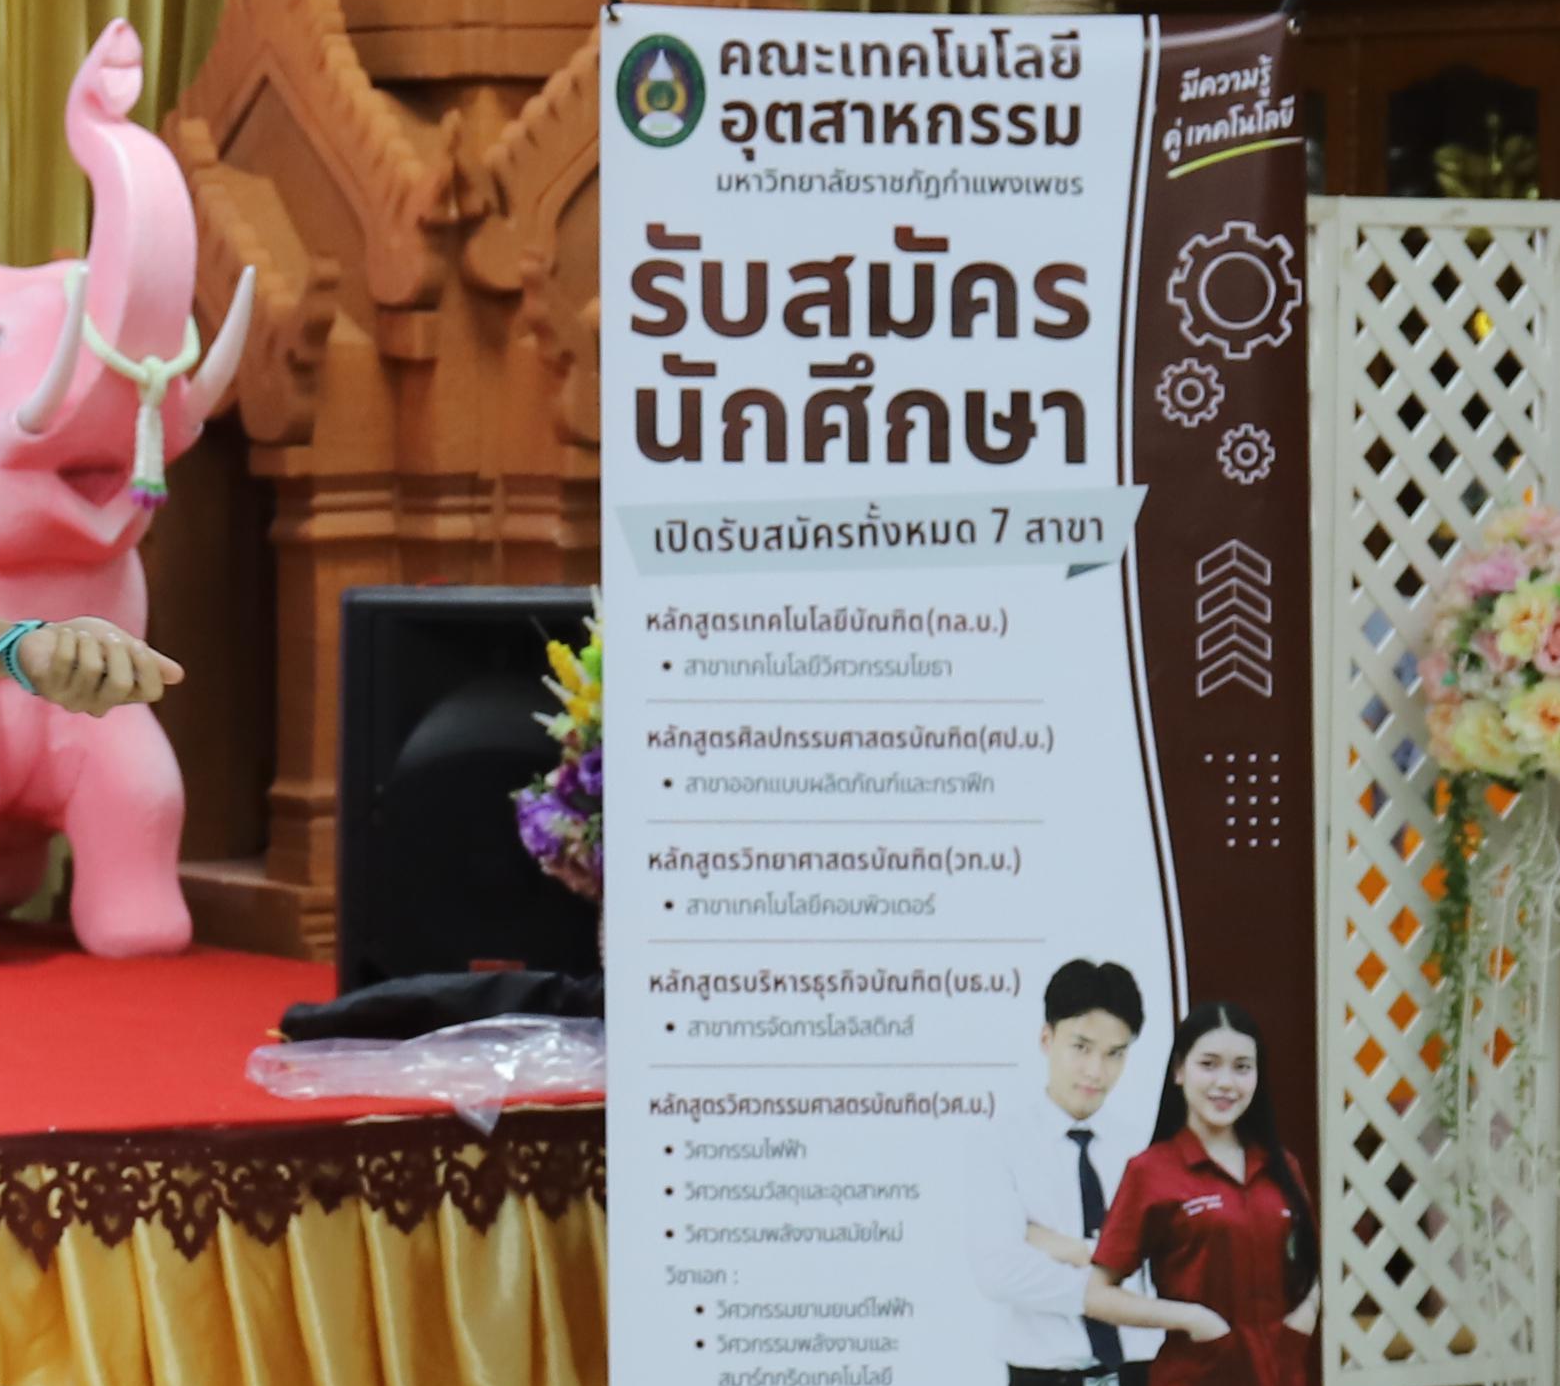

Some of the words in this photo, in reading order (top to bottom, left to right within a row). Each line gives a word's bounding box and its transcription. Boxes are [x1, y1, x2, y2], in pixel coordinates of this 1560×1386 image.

[718, 28, 1082, 81] คณะเทคโนโลยี
[1179, 53, 1273, 103] มีความรู้
[720, 97, 1081, 161] อุตสาหกรรม
[716, 165, 1084, 200] มหาวิทยาลัยราชภัฏกำแพงเพชร
[628, 222, 1093, 340] รับสมัคร
[633, 352, 1088, 466] นักศึกษา
[652, 501, 978, 556] เปิดรับสมัครทั้งหมด
[991, 507, 1011, 545] 7
[1025, 510, 1104, 546] สาขา
